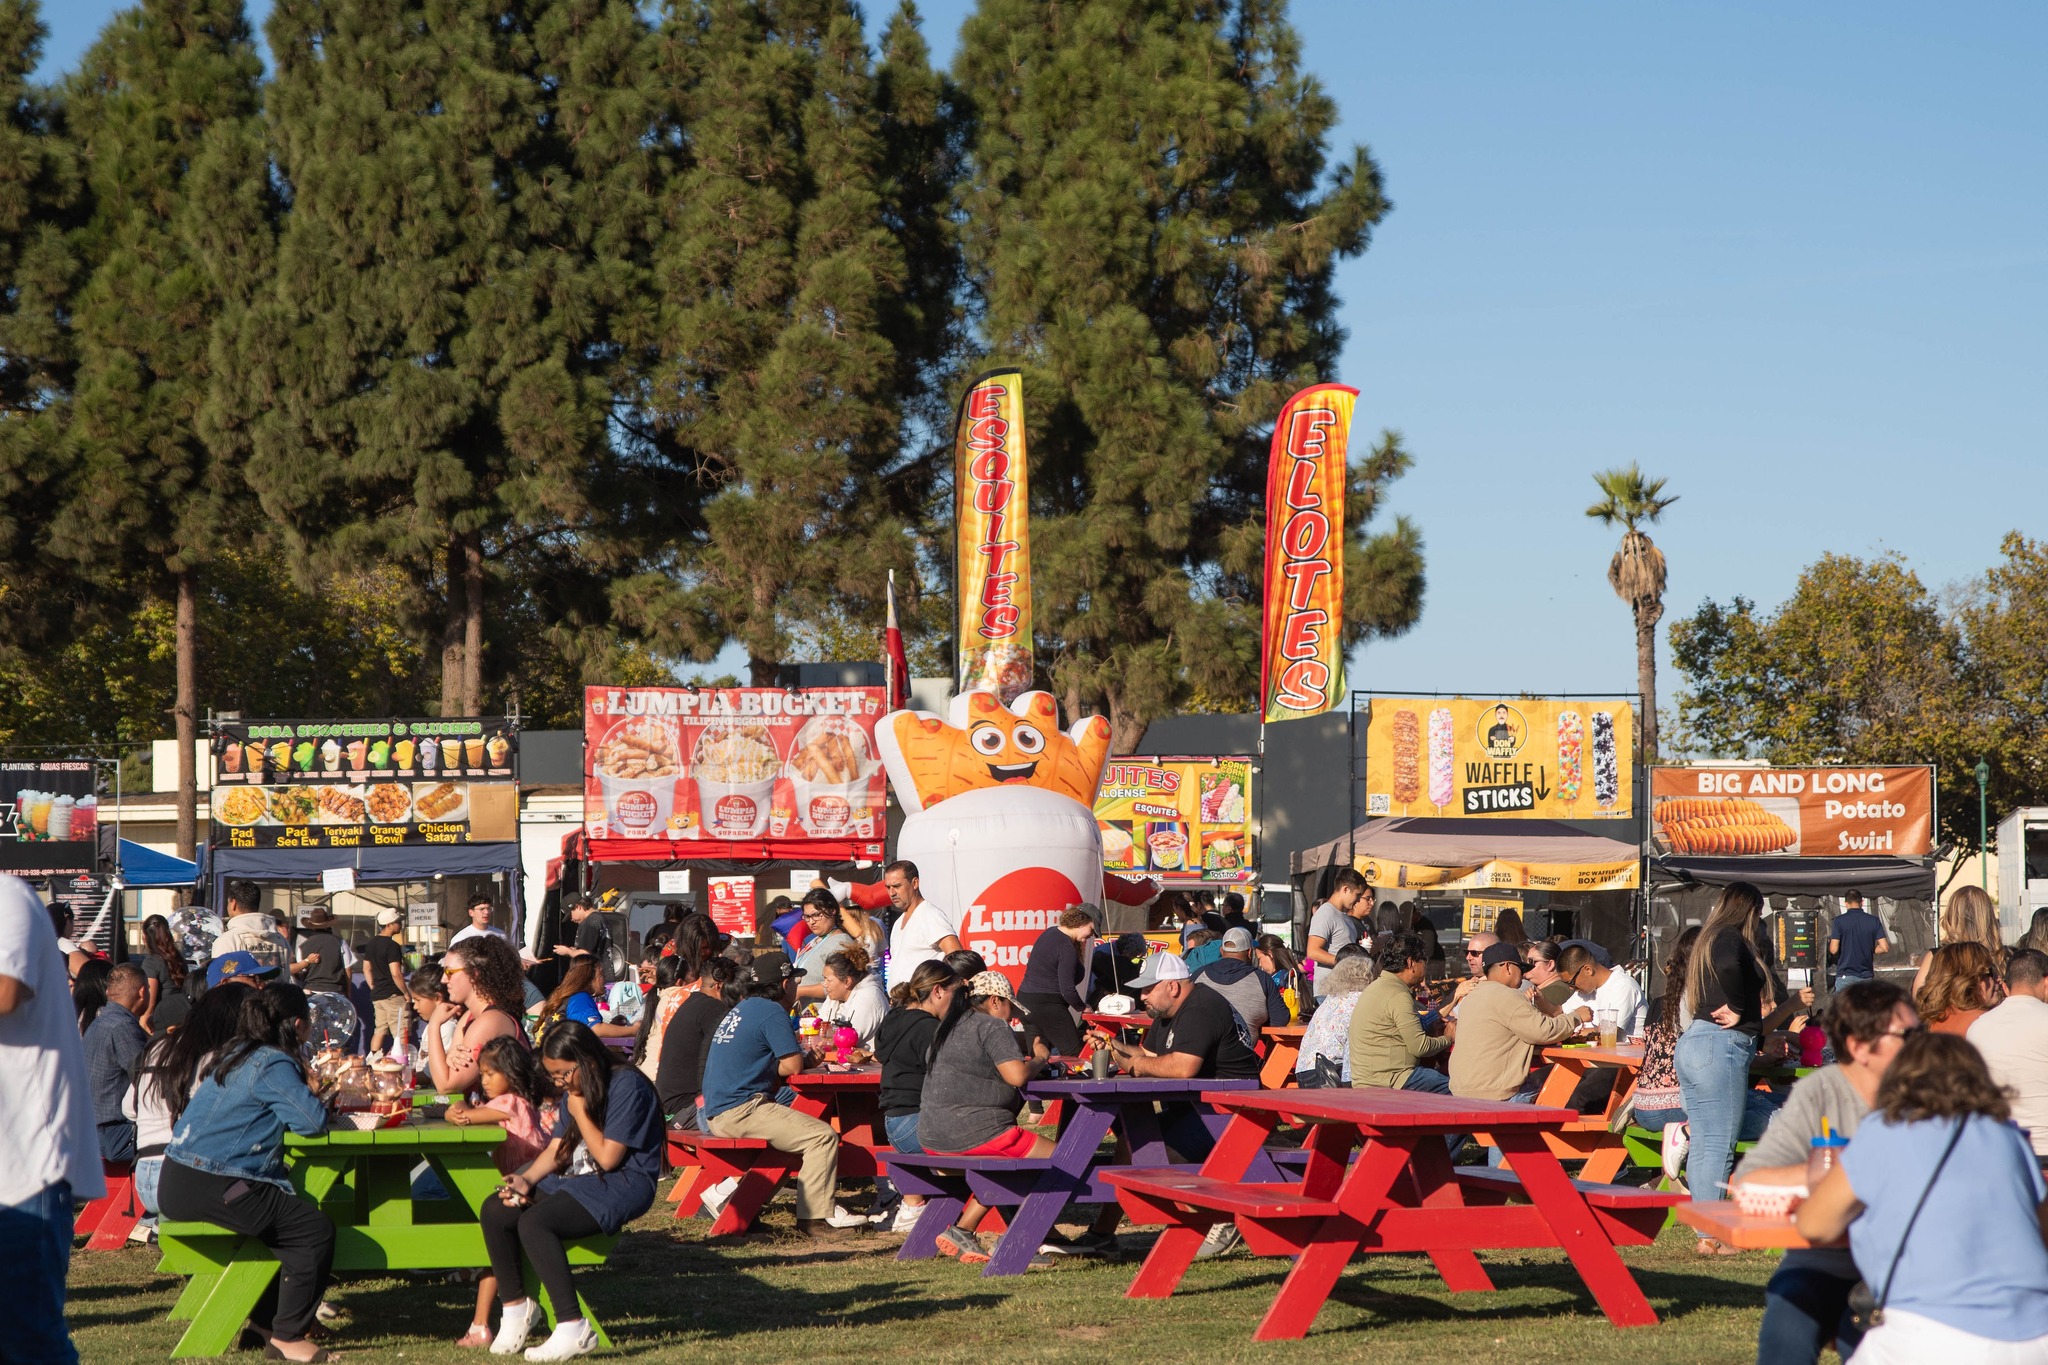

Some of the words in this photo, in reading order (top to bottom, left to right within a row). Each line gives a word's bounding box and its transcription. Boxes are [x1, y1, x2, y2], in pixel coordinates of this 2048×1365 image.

[966, 385, 1020, 639] ESQUITES
[1275, 409, 1336, 710] ELOTES
[607, 692, 729, 715] LUMPIA
[740, 692, 866, 716] BUCKET
[683, 717, 732, 726] FILIPINO
[733, 717, 791, 726] EGGROLLS
[248, 726, 294, 738] BOBA
[297, 724, 390, 737] SMOOTHIES
[393, 723, 407, 735] &
[410, 722, 481, 735] SLUSHES
[1493, 740, 1511, 748] DON
[1487, 747, 1517, 756] WAFFLY
[1, 763, 35, 771] PLANTAINS
[40, 762, 60, 771] AGUAS
[61, 762, 89, 771] FRESCAS
[1222, 760, 1245, 770] CORN
[1221, 767, 1244, 777] CORN
[1466, 762, 1533, 784] WAFFLE
[1103, 765, 1180, 791] UITES
[1698, 773, 1742, 793] BIG
[1748, 774, 1805, 794] AND
[1812, 773, 1885, 794] LONG
[1099, 789, 1146, 798] ALOENSE
[1467, 787, 1532, 810] STICKS
[620, 810, 655, 818] BUCKET
[718, 805, 754, 813] LUMPIA
[812, 805, 848, 813] LUMPIA
[1134, 804, 1177, 817] ESQUITES
[1825, 800, 1905, 819] Potato
[719, 812, 755, 821] BUCKET
[812, 812, 848, 821] BUCKET
[231, 828, 253, 838] Pad
[285, 827, 308, 837] Pad
[323, 826, 363, 837] Teriyaki
[370, 826, 407, 835] Orange
[418, 823, 463, 833] Chicken
[230, 838, 255, 847] Thai
[277, 837, 298, 846] See
[301, 837, 318, 846] Ew
[330, 836, 359, 846] Bowl
[375, 835, 403, 844] Bowl
[425, 833, 456, 843] Satay
[1838, 830, 1892, 851] Swirl
[1600, 874, 1632, 883] AVAILABLE
[968, 903, 1073, 933] Lump
